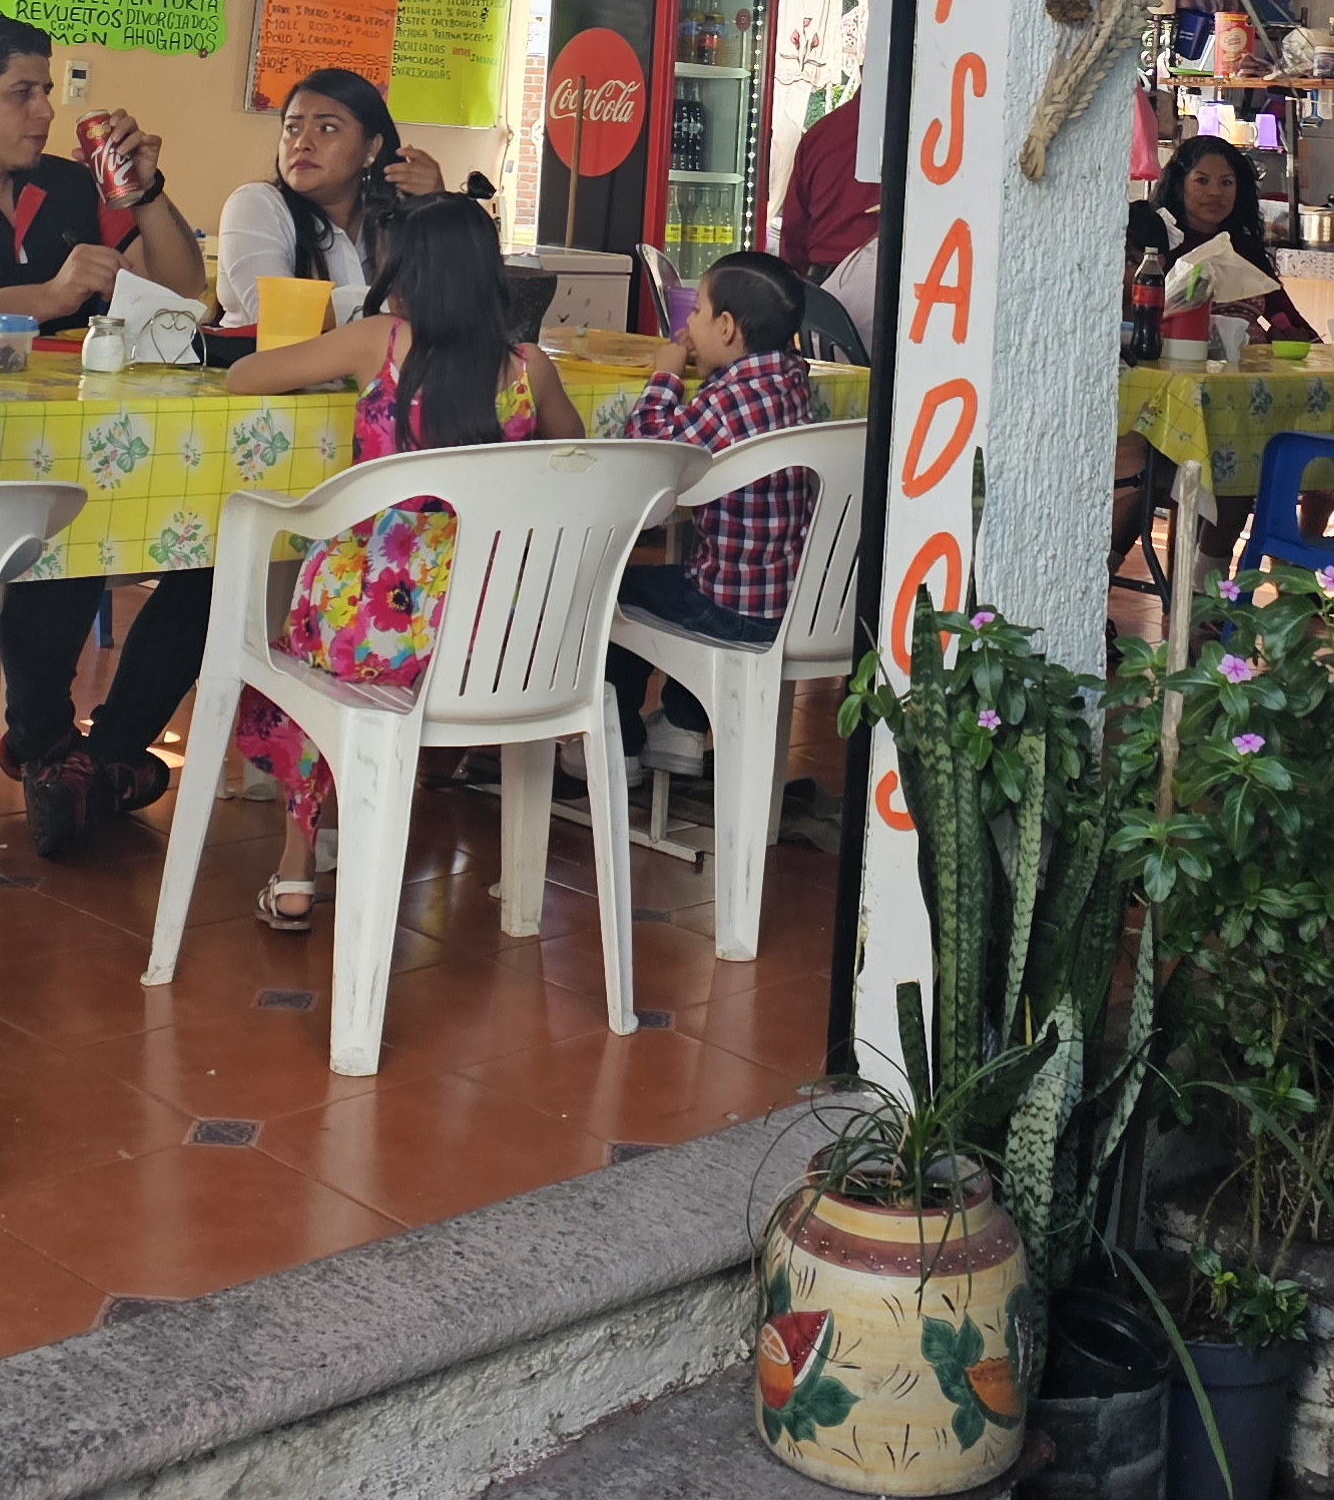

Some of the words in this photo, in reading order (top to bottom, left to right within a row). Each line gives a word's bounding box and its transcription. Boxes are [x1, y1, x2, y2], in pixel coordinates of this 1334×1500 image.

[50, 21, 74, 32] CON
[126, 10, 219, 32] DIVORCIADOS
[265, 19, 298, 30] MOLE
[309, 20, 339, 33] ROJO
[123, 26, 217, 53] AHOGADOS
[266, 31, 292, 44] POLLO
[394, 40, 446, 54] ENCHILADAS
[392, 65, 451, 80] ENFRIJOLADAS
